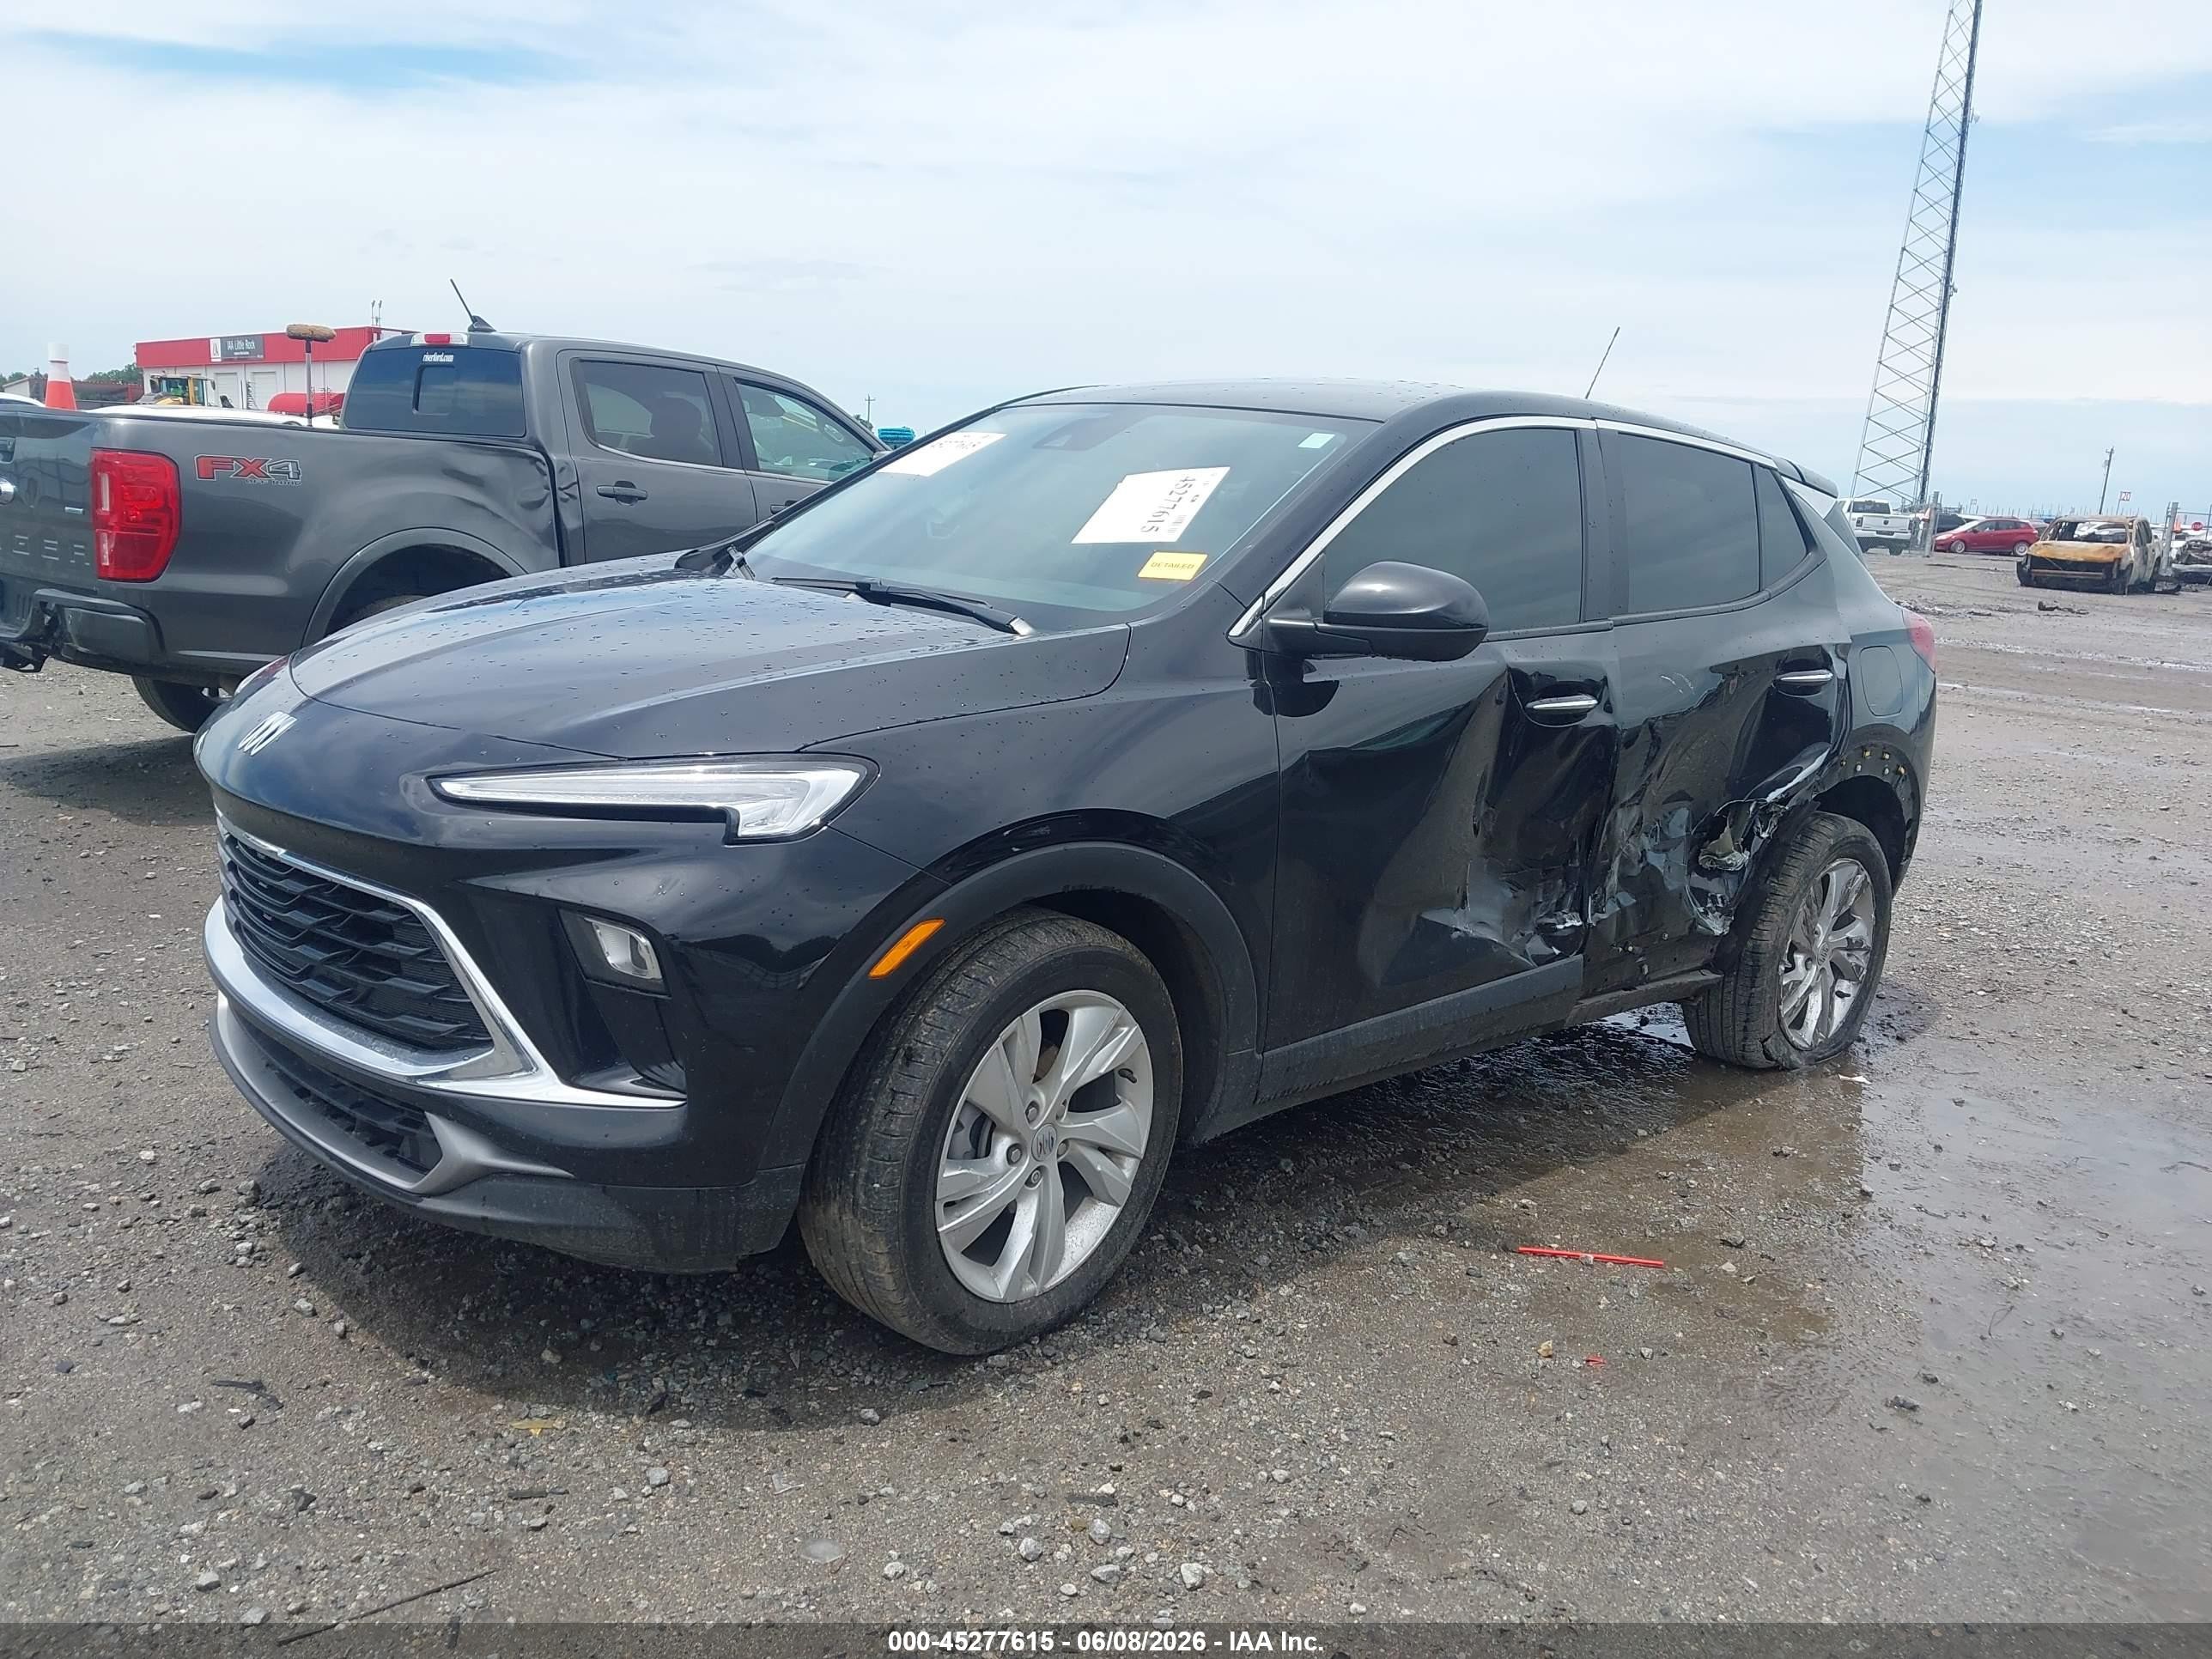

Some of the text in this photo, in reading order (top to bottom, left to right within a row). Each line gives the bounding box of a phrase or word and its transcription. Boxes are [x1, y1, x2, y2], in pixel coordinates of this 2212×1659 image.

[234, 340, 244, 349] Little
[245, 338, 255, 349] Rock
[194, 453, 301, 481] FX4
[1139, 476, 1196, 532] 45277615
